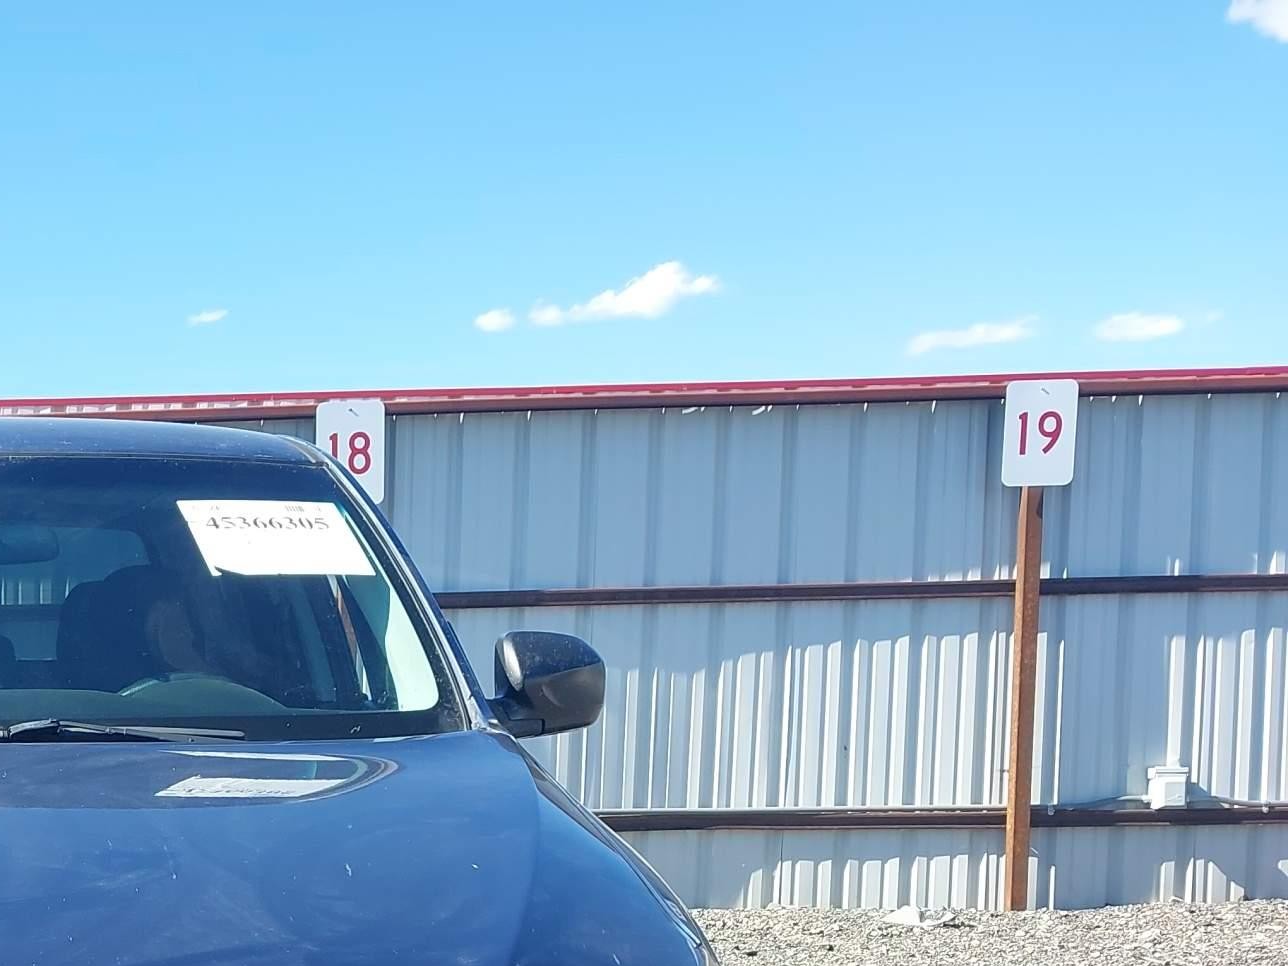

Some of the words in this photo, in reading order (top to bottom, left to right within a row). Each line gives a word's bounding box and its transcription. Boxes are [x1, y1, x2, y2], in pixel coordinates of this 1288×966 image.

[328, 431, 371, 475] 18
[1018, 410, 1063, 456] 19
[206, 516, 330, 530] 45366305
